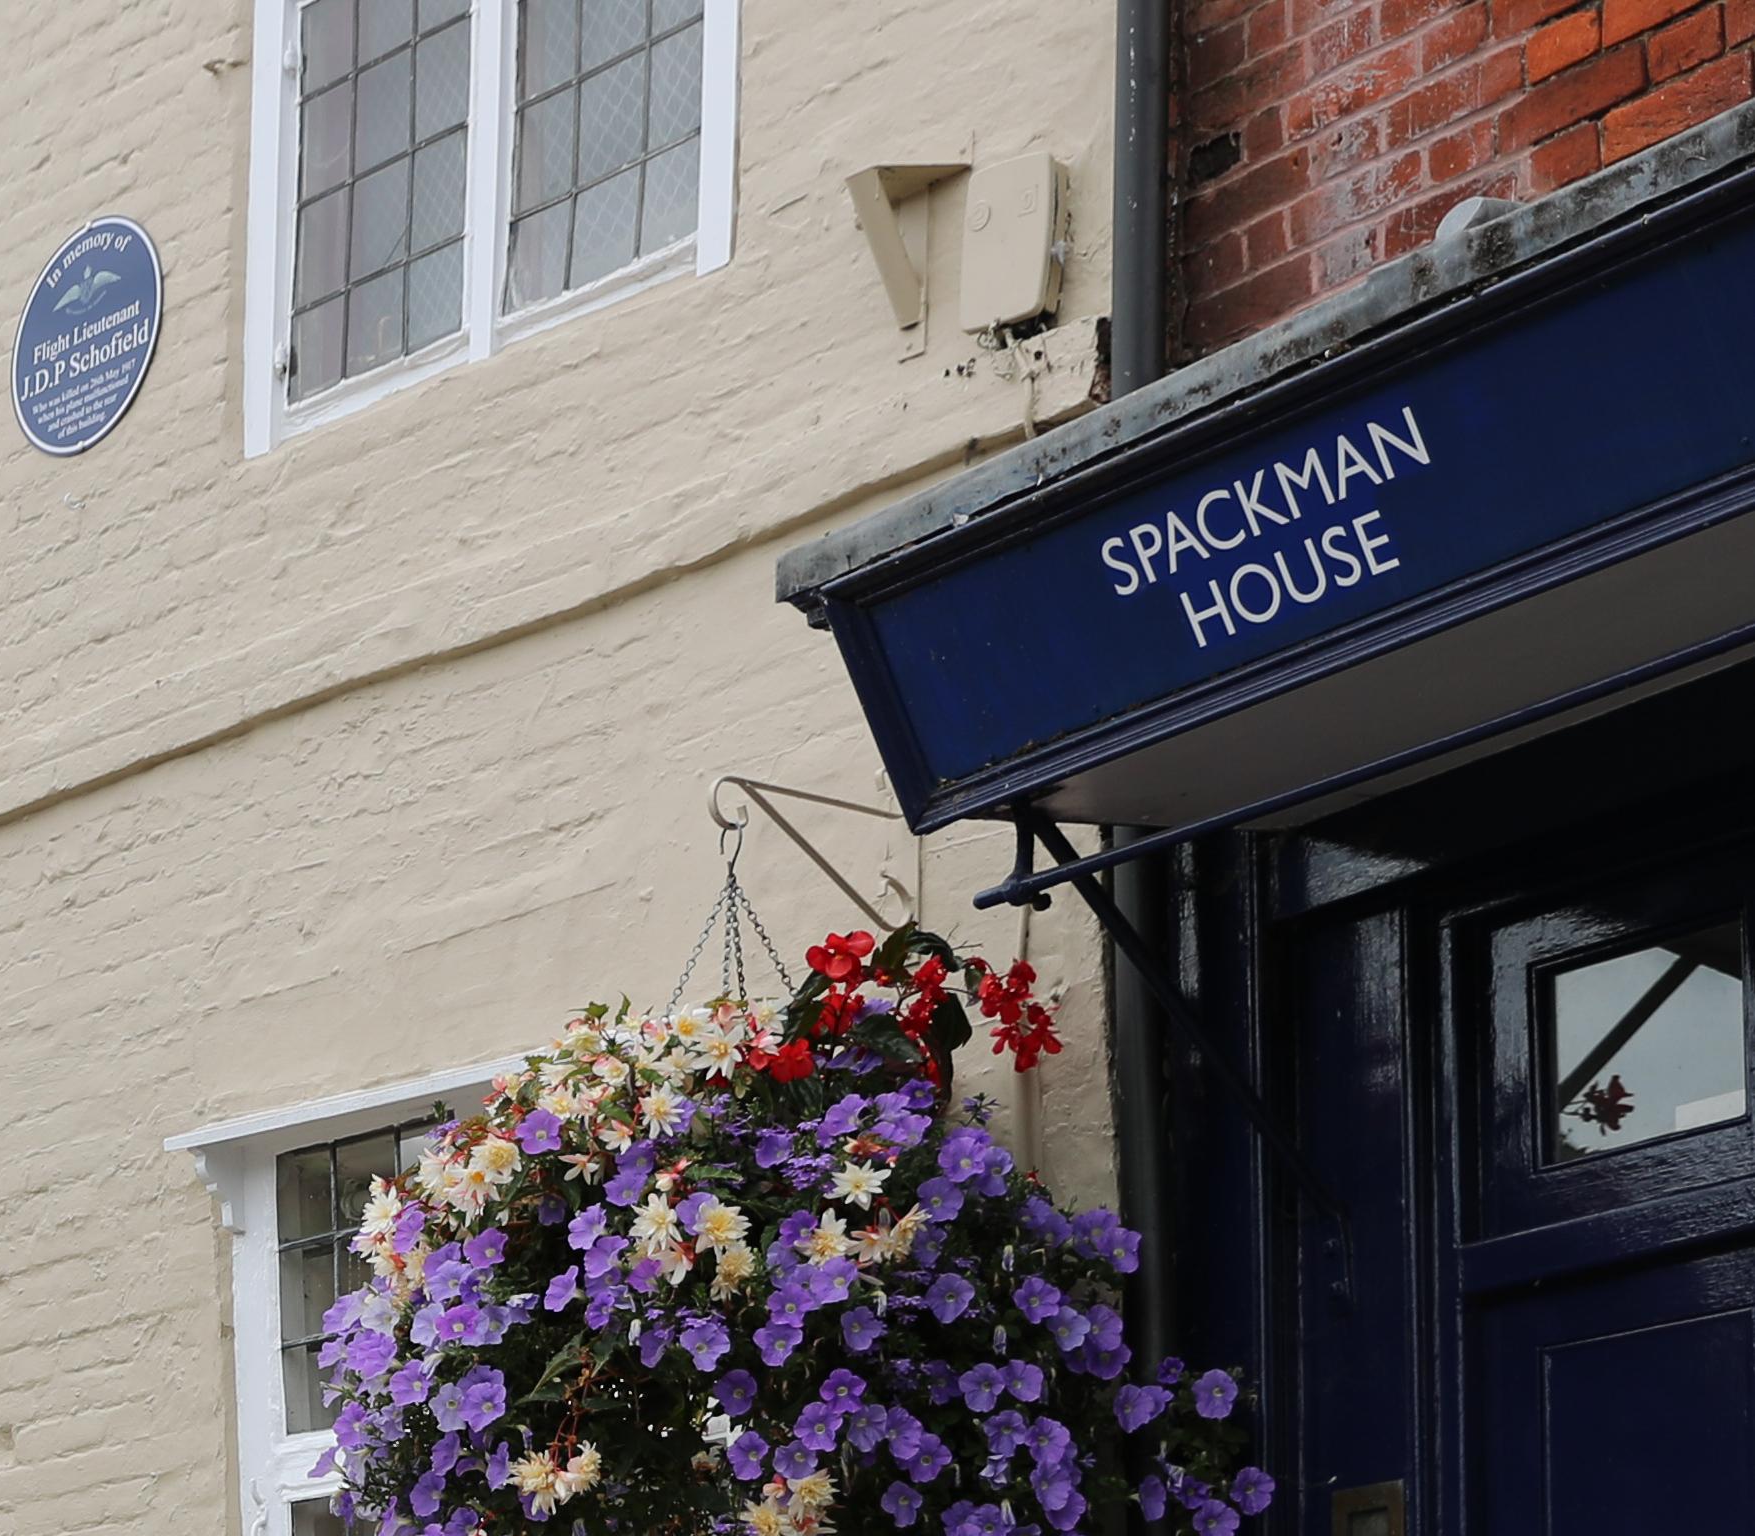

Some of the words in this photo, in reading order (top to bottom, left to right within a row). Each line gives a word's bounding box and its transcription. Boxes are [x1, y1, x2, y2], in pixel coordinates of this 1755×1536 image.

[45, 268, 62, 289] In
[62, 231, 115, 267] memory
[114, 234, 133, 252] of
[20, 359, 66, 402] J.D.P
[68, 318, 150, 379] Schofield
[32, 333, 70, 366] Flight
[72, 299, 141, 346] Lieutenant
[1101, 406, 1431, 596] SPACKMAN
[1179, 509, 1400, 648] HOUSE
